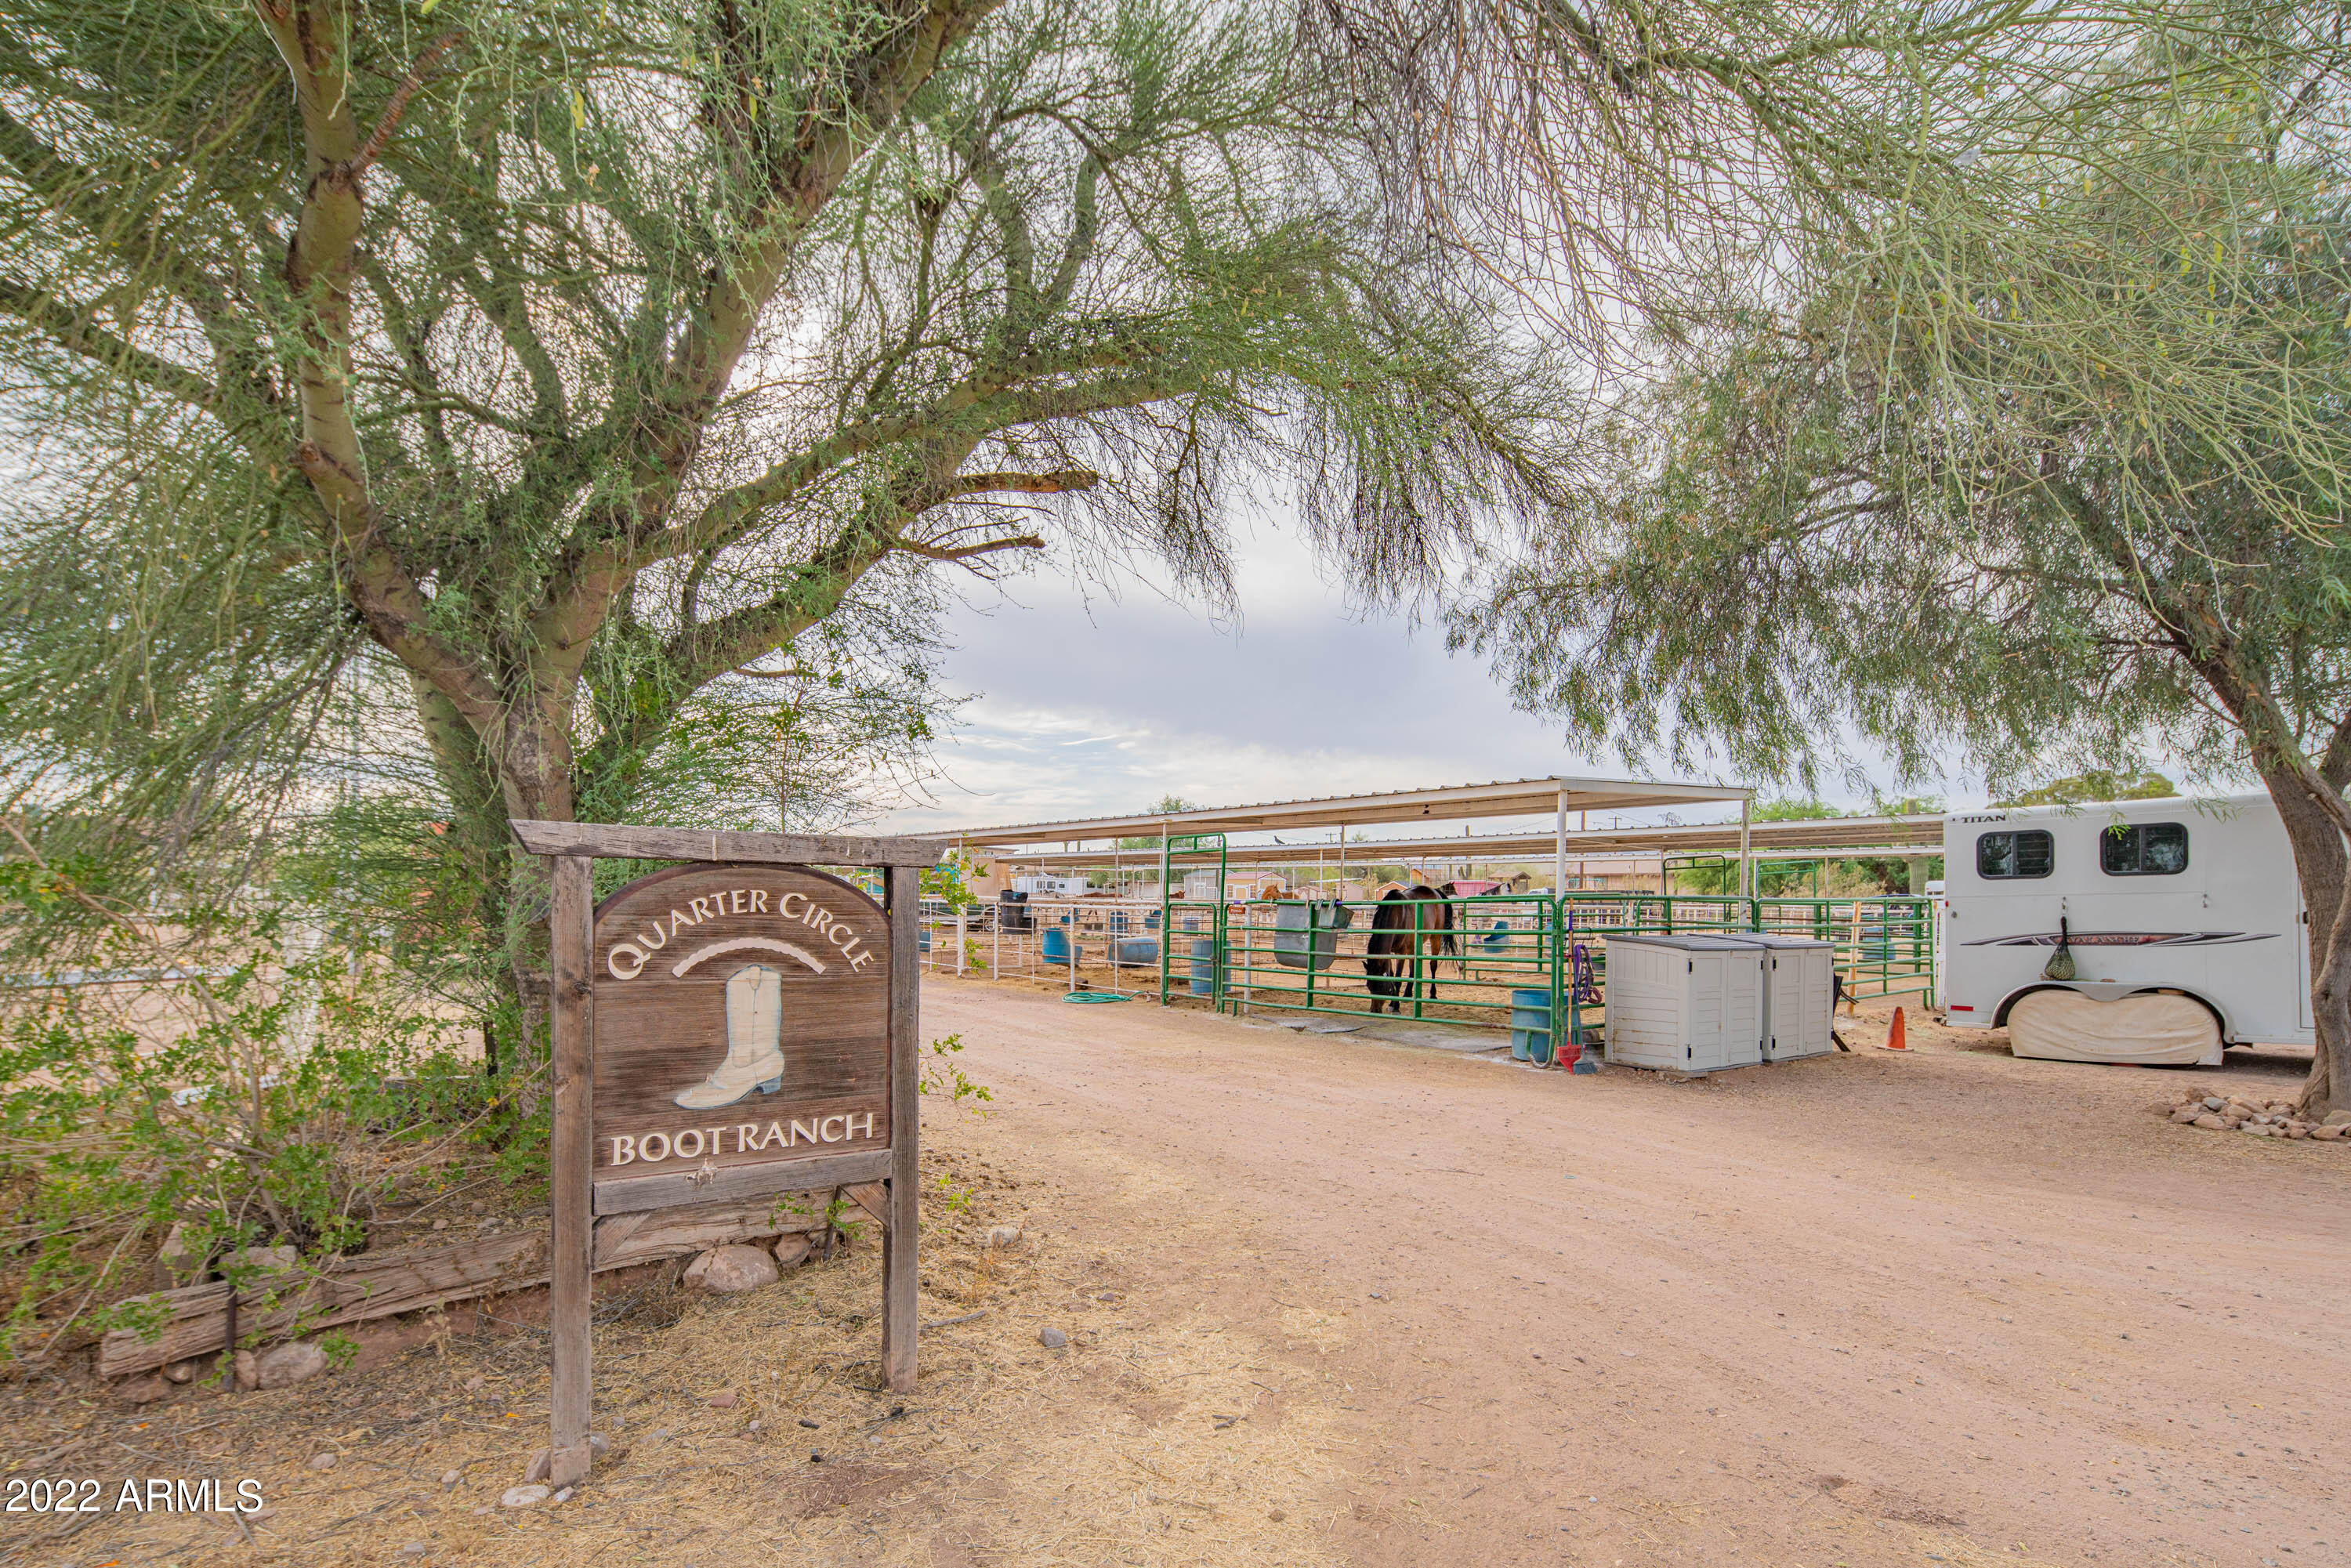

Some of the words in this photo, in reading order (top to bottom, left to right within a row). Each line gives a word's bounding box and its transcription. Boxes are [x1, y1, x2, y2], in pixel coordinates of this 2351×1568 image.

[1962, 815, 2006, 824] TITAN
[608, 889, 769, 980] QUARTER
[779, 893, 874, 972] CIRCLE
[2066, 935, 2139, 945] VALANCHE
[610, 1127, 727, 1166] BOOT
[737, 1113, 873, 1153] RANCH
